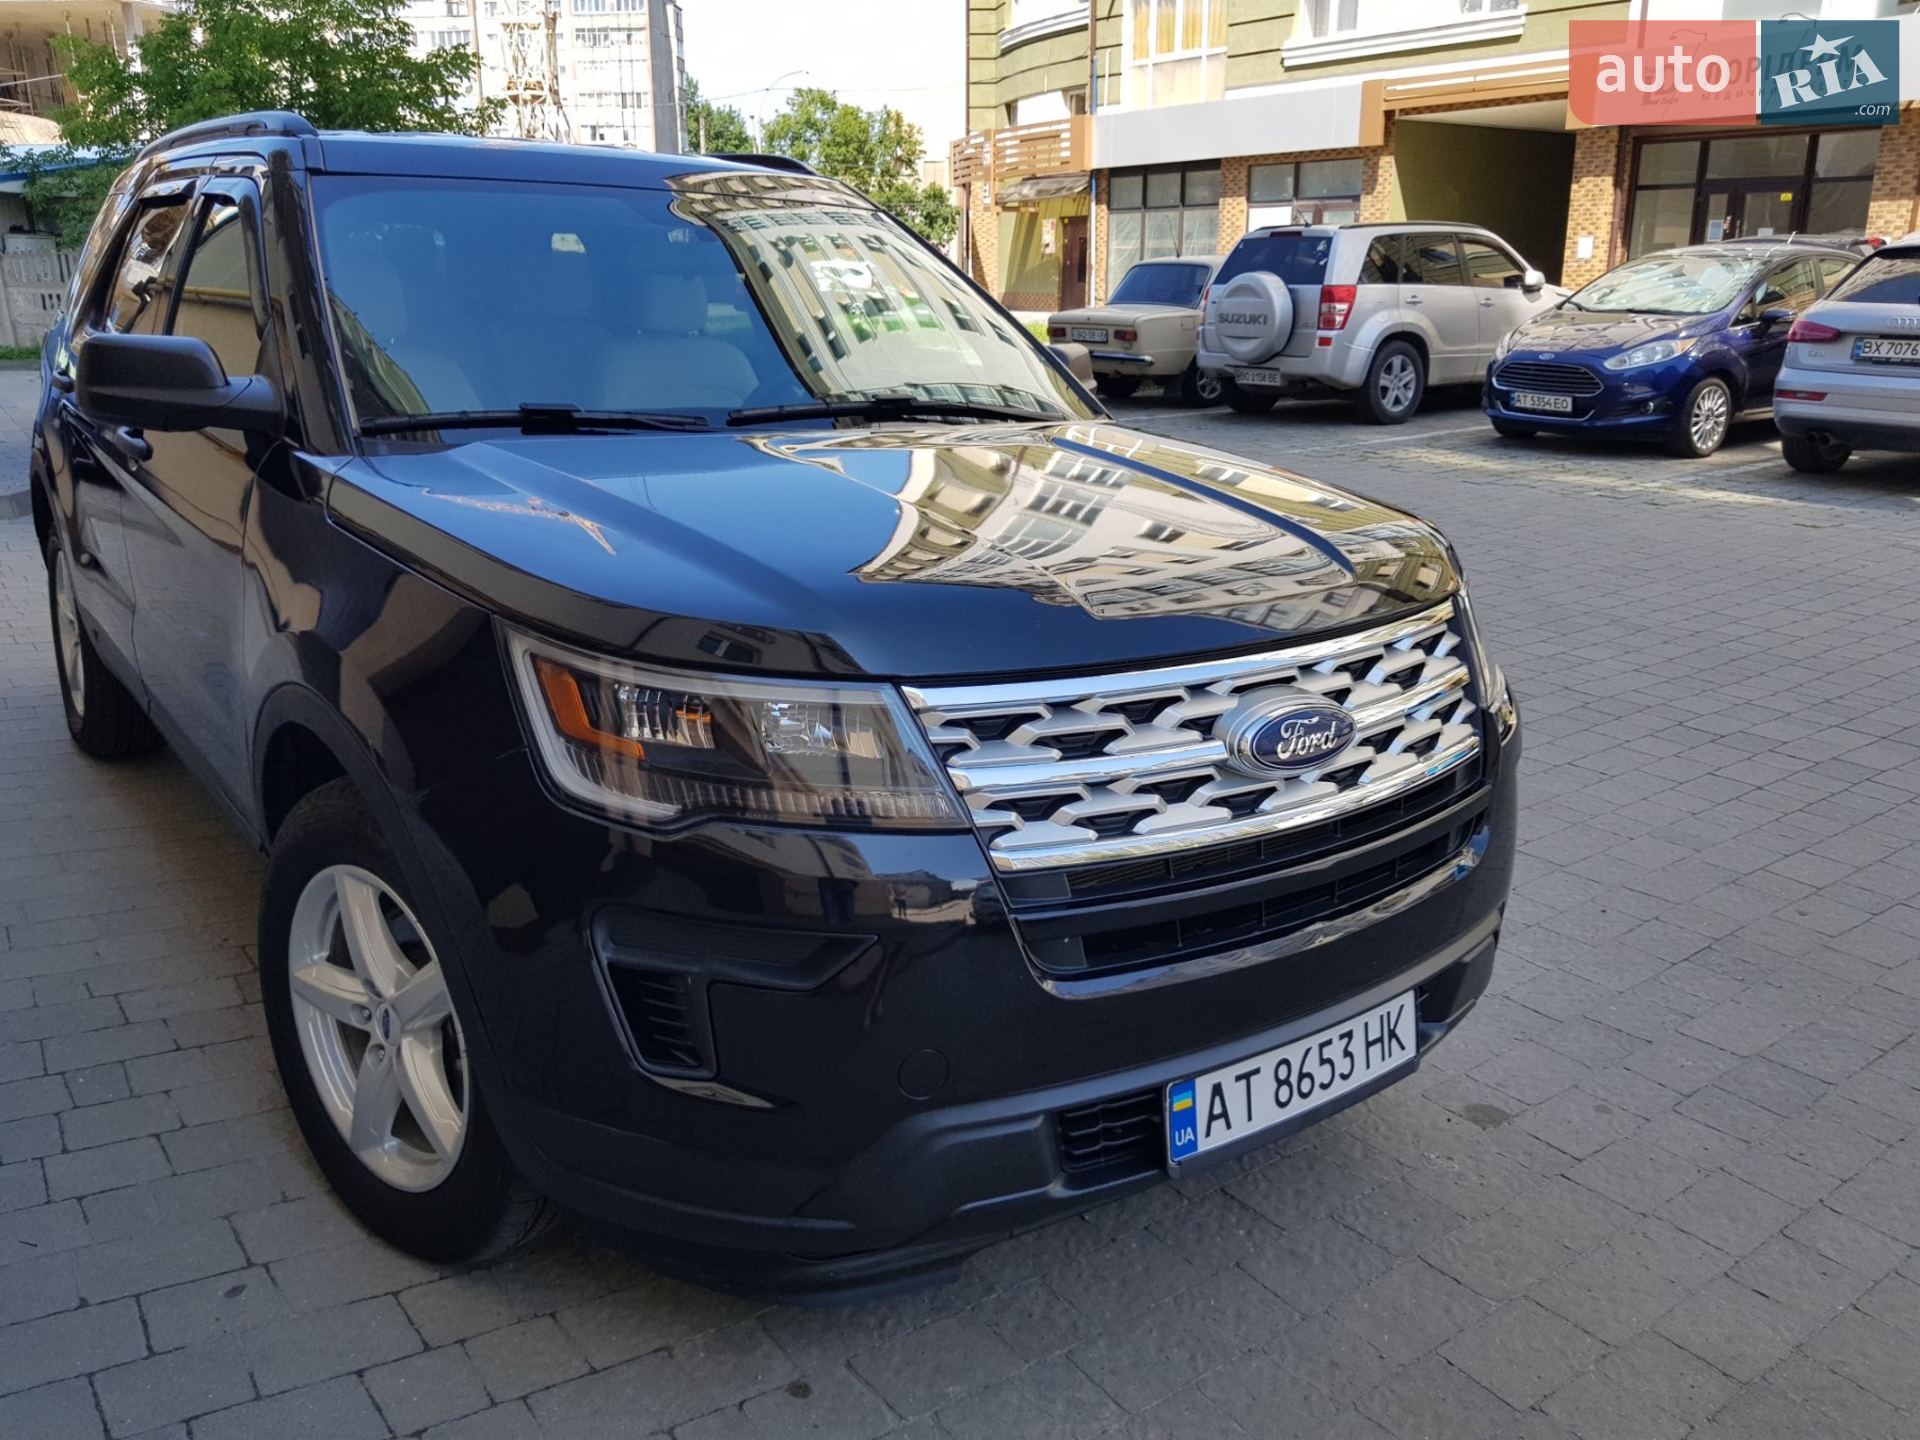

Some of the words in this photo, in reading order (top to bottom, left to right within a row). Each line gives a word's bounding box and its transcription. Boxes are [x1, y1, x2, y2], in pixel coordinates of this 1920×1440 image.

[1218, 312, 1268, 325] SUZUKI
[1862, 341, 1884, 355] BX
[1885, 341, 1920, 356] 7076
[1530, 395, 1552, 408] 5354
[1277, 716, 1338, 760] Ford
[1205, 1067, 1262, 1139] AT
[1274, 1029, 1356, 1109] 8653
[1364, 1004, 1406, 1070] HK
[1174, 1126, 1195, 1147] UA
